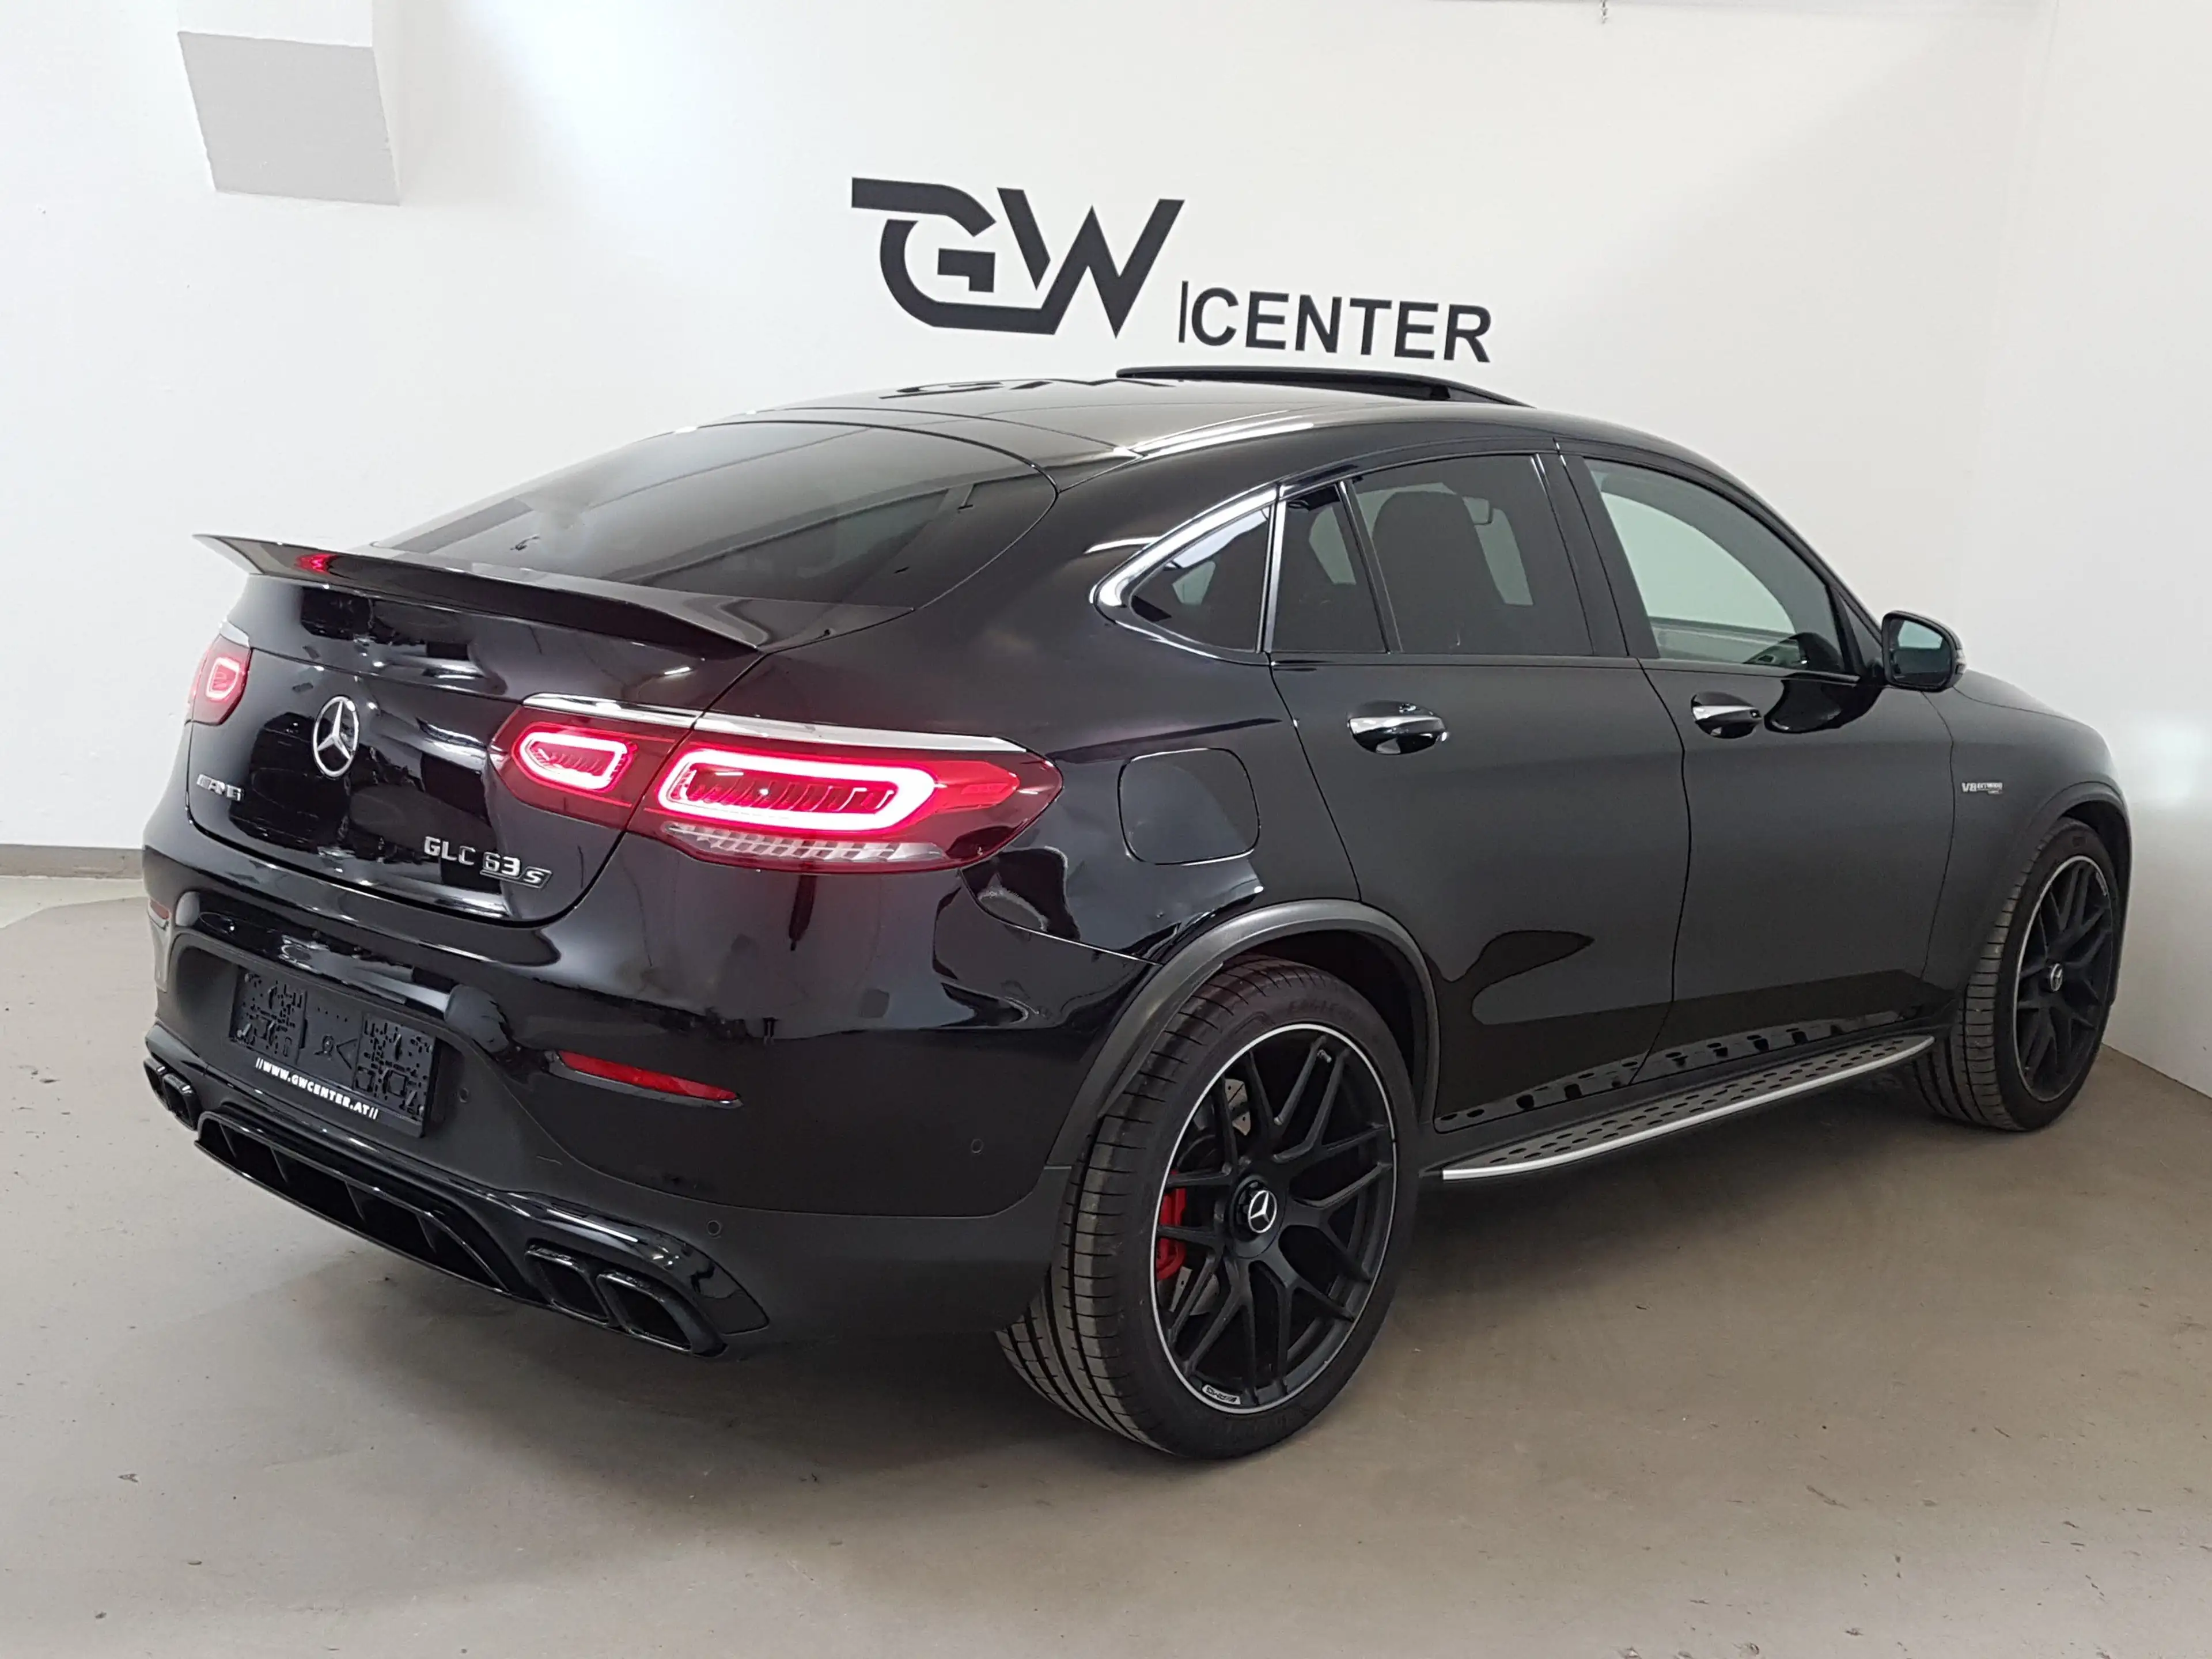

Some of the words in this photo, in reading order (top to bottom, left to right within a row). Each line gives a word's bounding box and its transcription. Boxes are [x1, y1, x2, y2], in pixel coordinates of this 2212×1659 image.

[852, 178, 1185, 339] GW
[424, 836, 476, 866] GLC
[483, 851, 521, 877] 63
